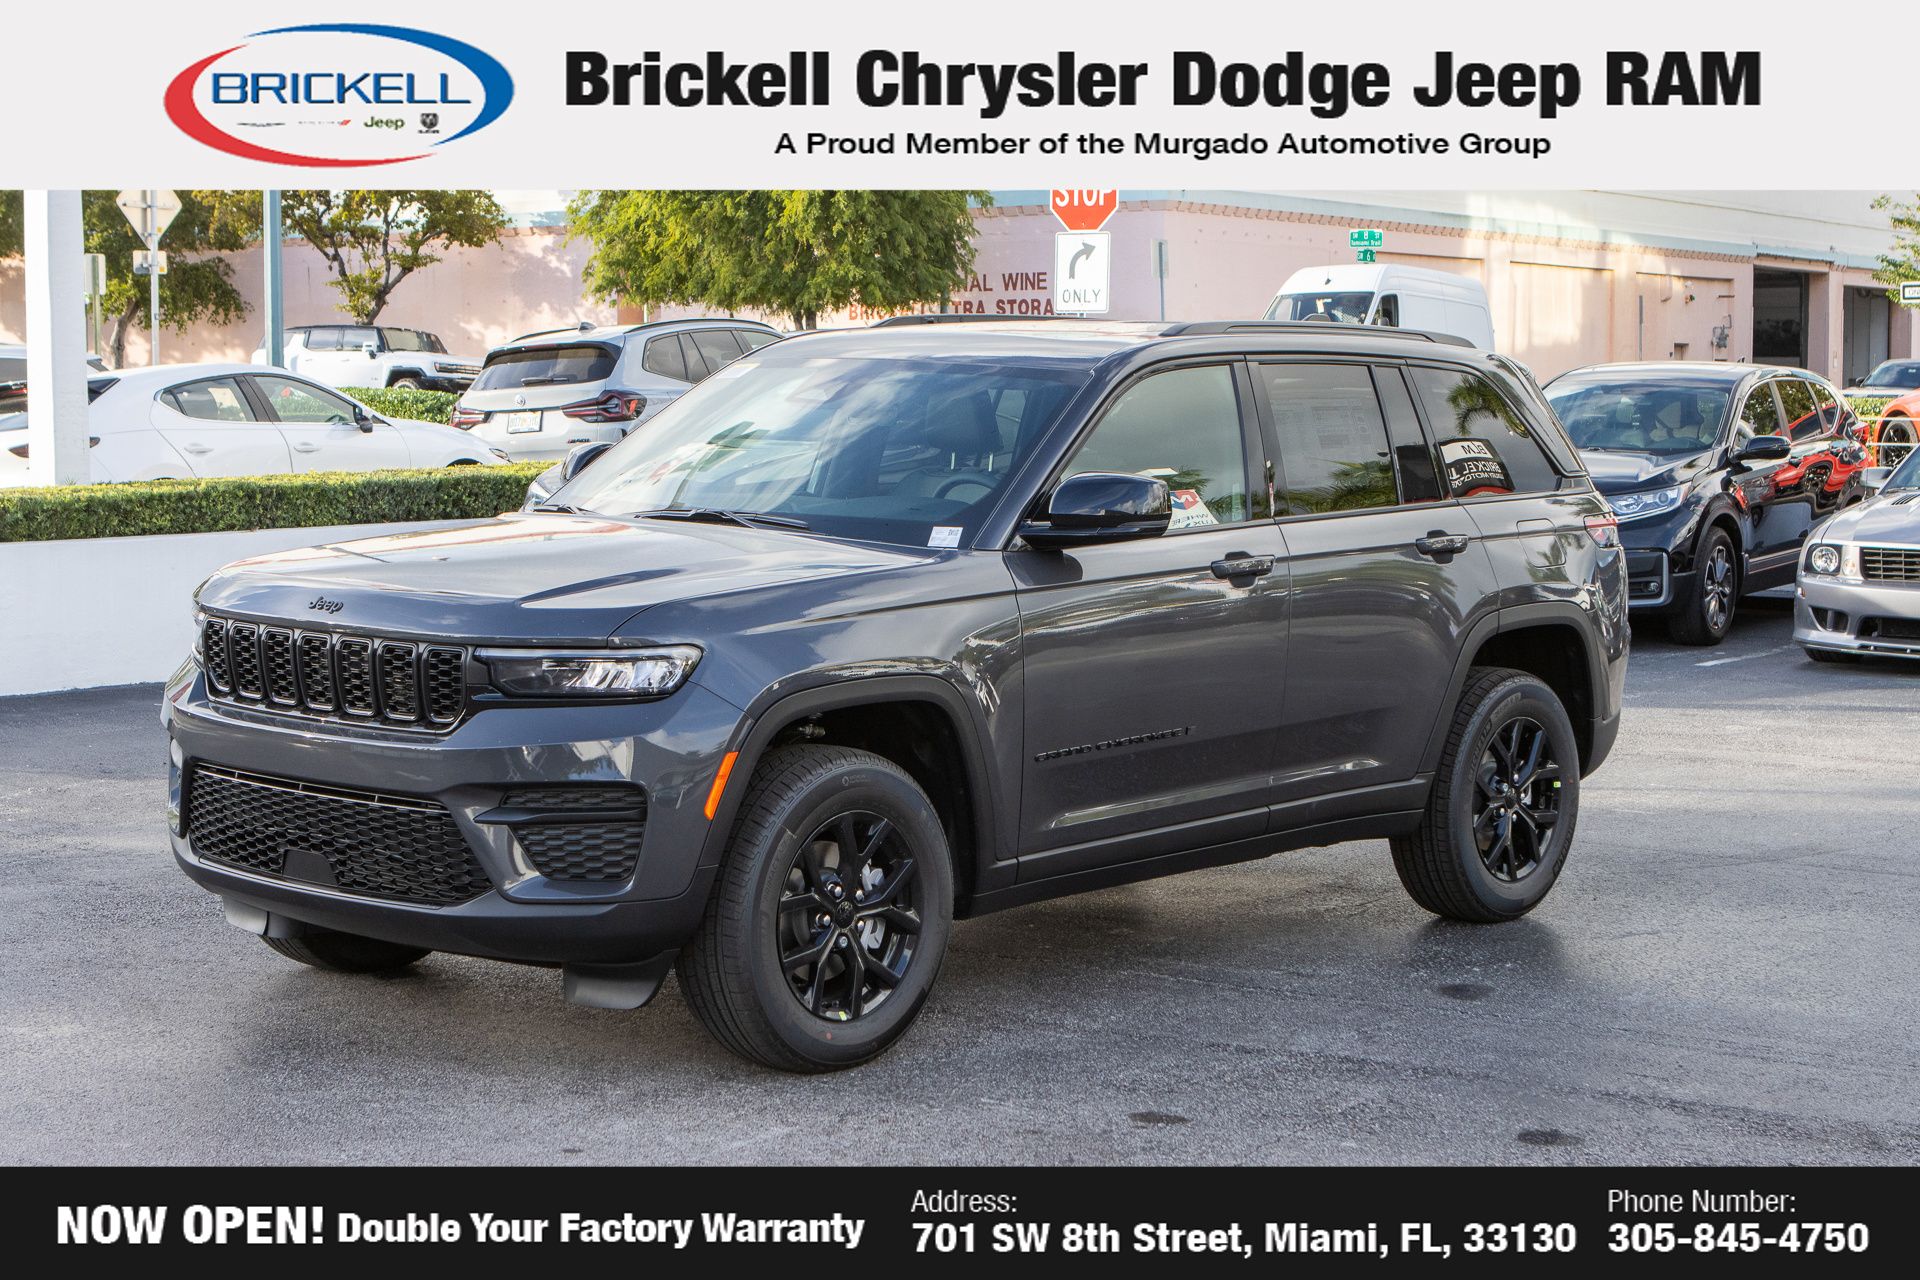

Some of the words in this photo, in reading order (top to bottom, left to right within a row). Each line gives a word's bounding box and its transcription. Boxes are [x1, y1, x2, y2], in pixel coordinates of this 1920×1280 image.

[1055, 190, 1113, 207] STOP
[952, 274, 993, 292] NAL
[1002, 272, 1047, 291] WINE
[1062, 289, 1101, 303] ONLY
[996, 299, 1062, 316] STORA
[308, 596, 344, 615] Jeep
